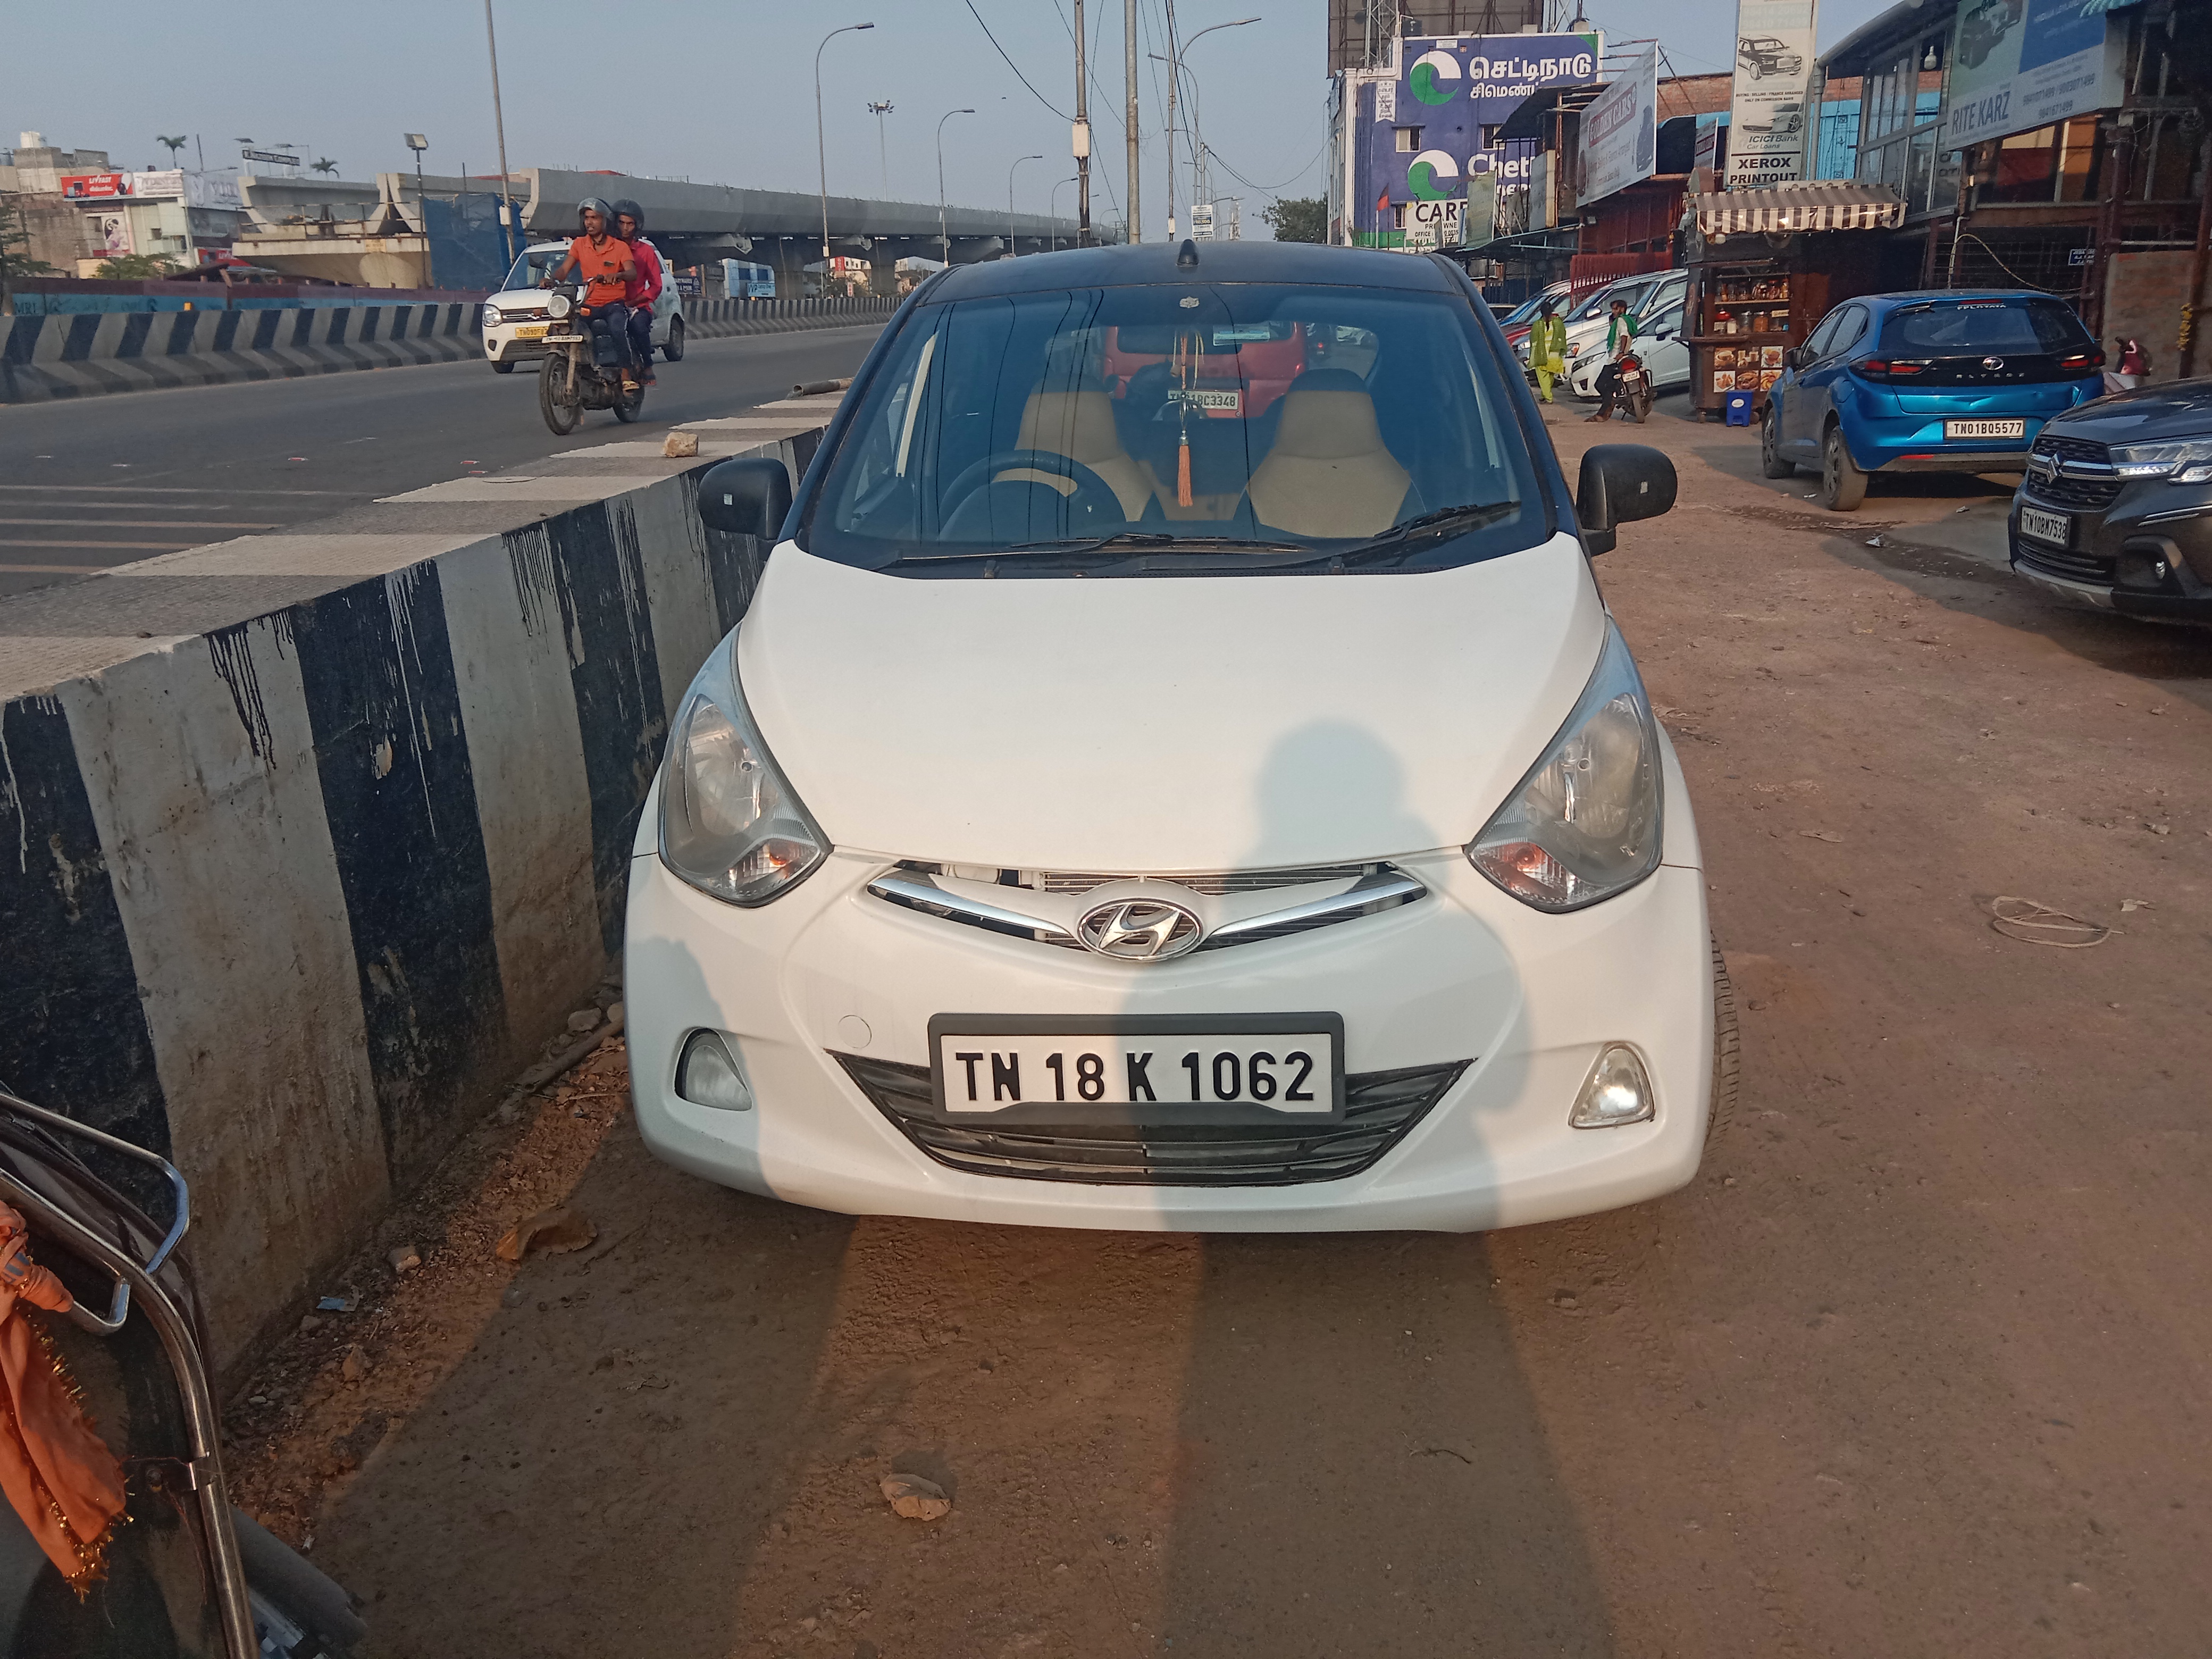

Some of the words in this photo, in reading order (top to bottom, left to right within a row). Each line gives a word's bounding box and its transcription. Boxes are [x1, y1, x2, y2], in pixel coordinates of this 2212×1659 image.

[1469, 53, 1593, 82] செட்டிநாடு
[1612, 93, 1632, 125] CARS
[1951, 102, 1976, 136] RITE
[1978, 90, 2010, 128] KARZ
[1738, 157, 1791, 170] XEROX
[1730, 172, 1798, 185] PRINTOUT
[1954, 422, 2022, 434] TN01BQ5577
[956, 1052, 1021, 1102] TN
[1045, 1052, 1105, 1102] 18
[1127, 1052, 1157, 1101] K
[1182, 1051, 1314, 1102] 1062
